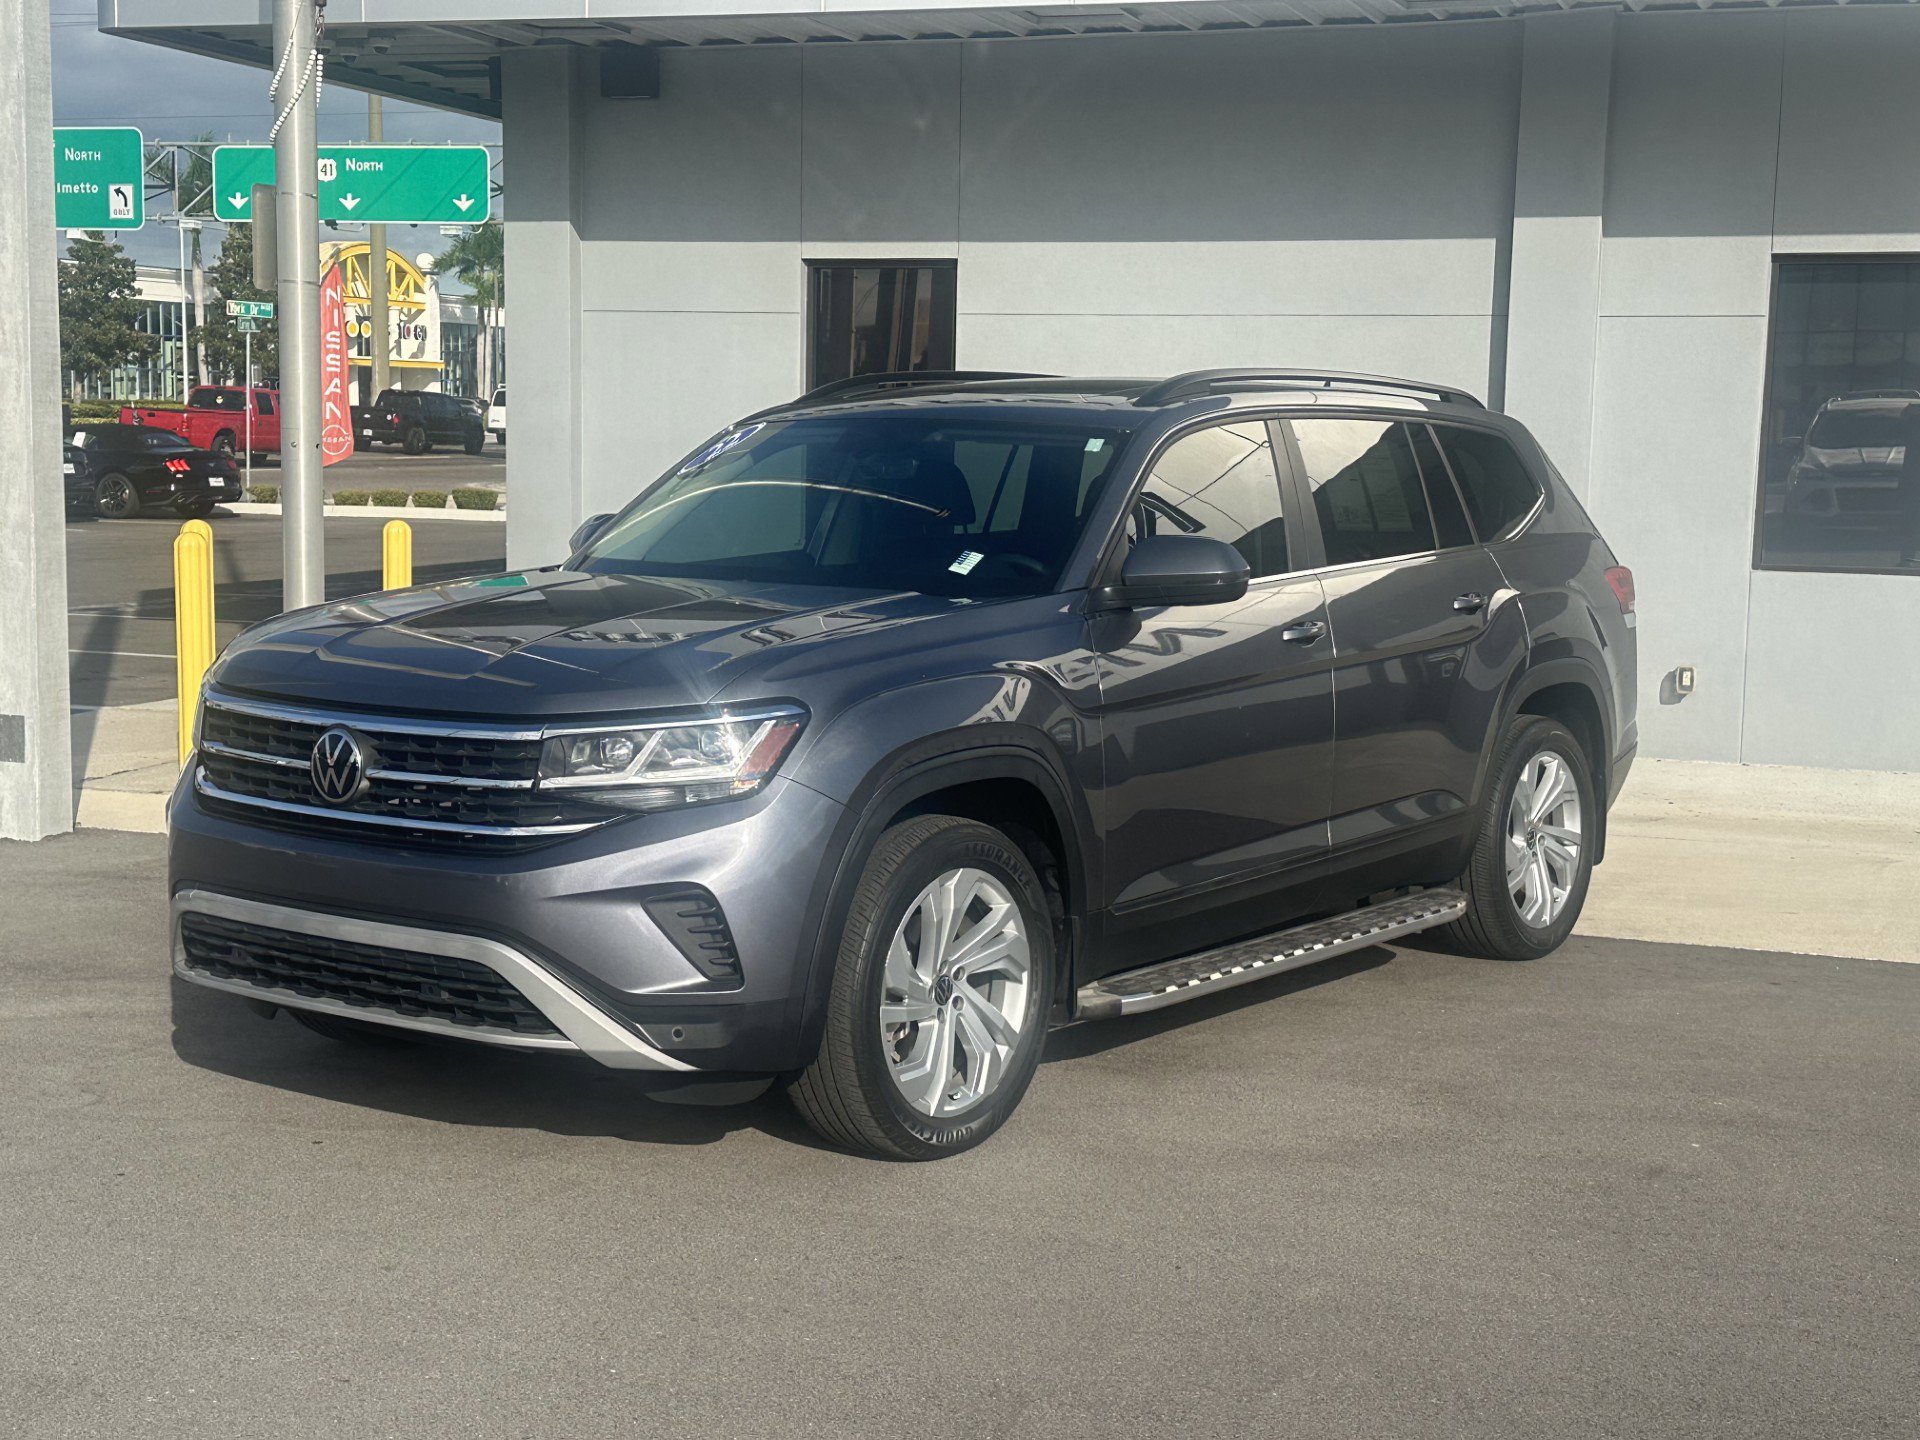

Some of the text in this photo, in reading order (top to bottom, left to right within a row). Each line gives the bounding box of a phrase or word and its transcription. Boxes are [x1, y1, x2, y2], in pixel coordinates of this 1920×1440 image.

[64, 147, 101, 161] NORTH
[320, 157, 383, 177] 41 NORTH
[325, 285, 342, 420] NISSAN
